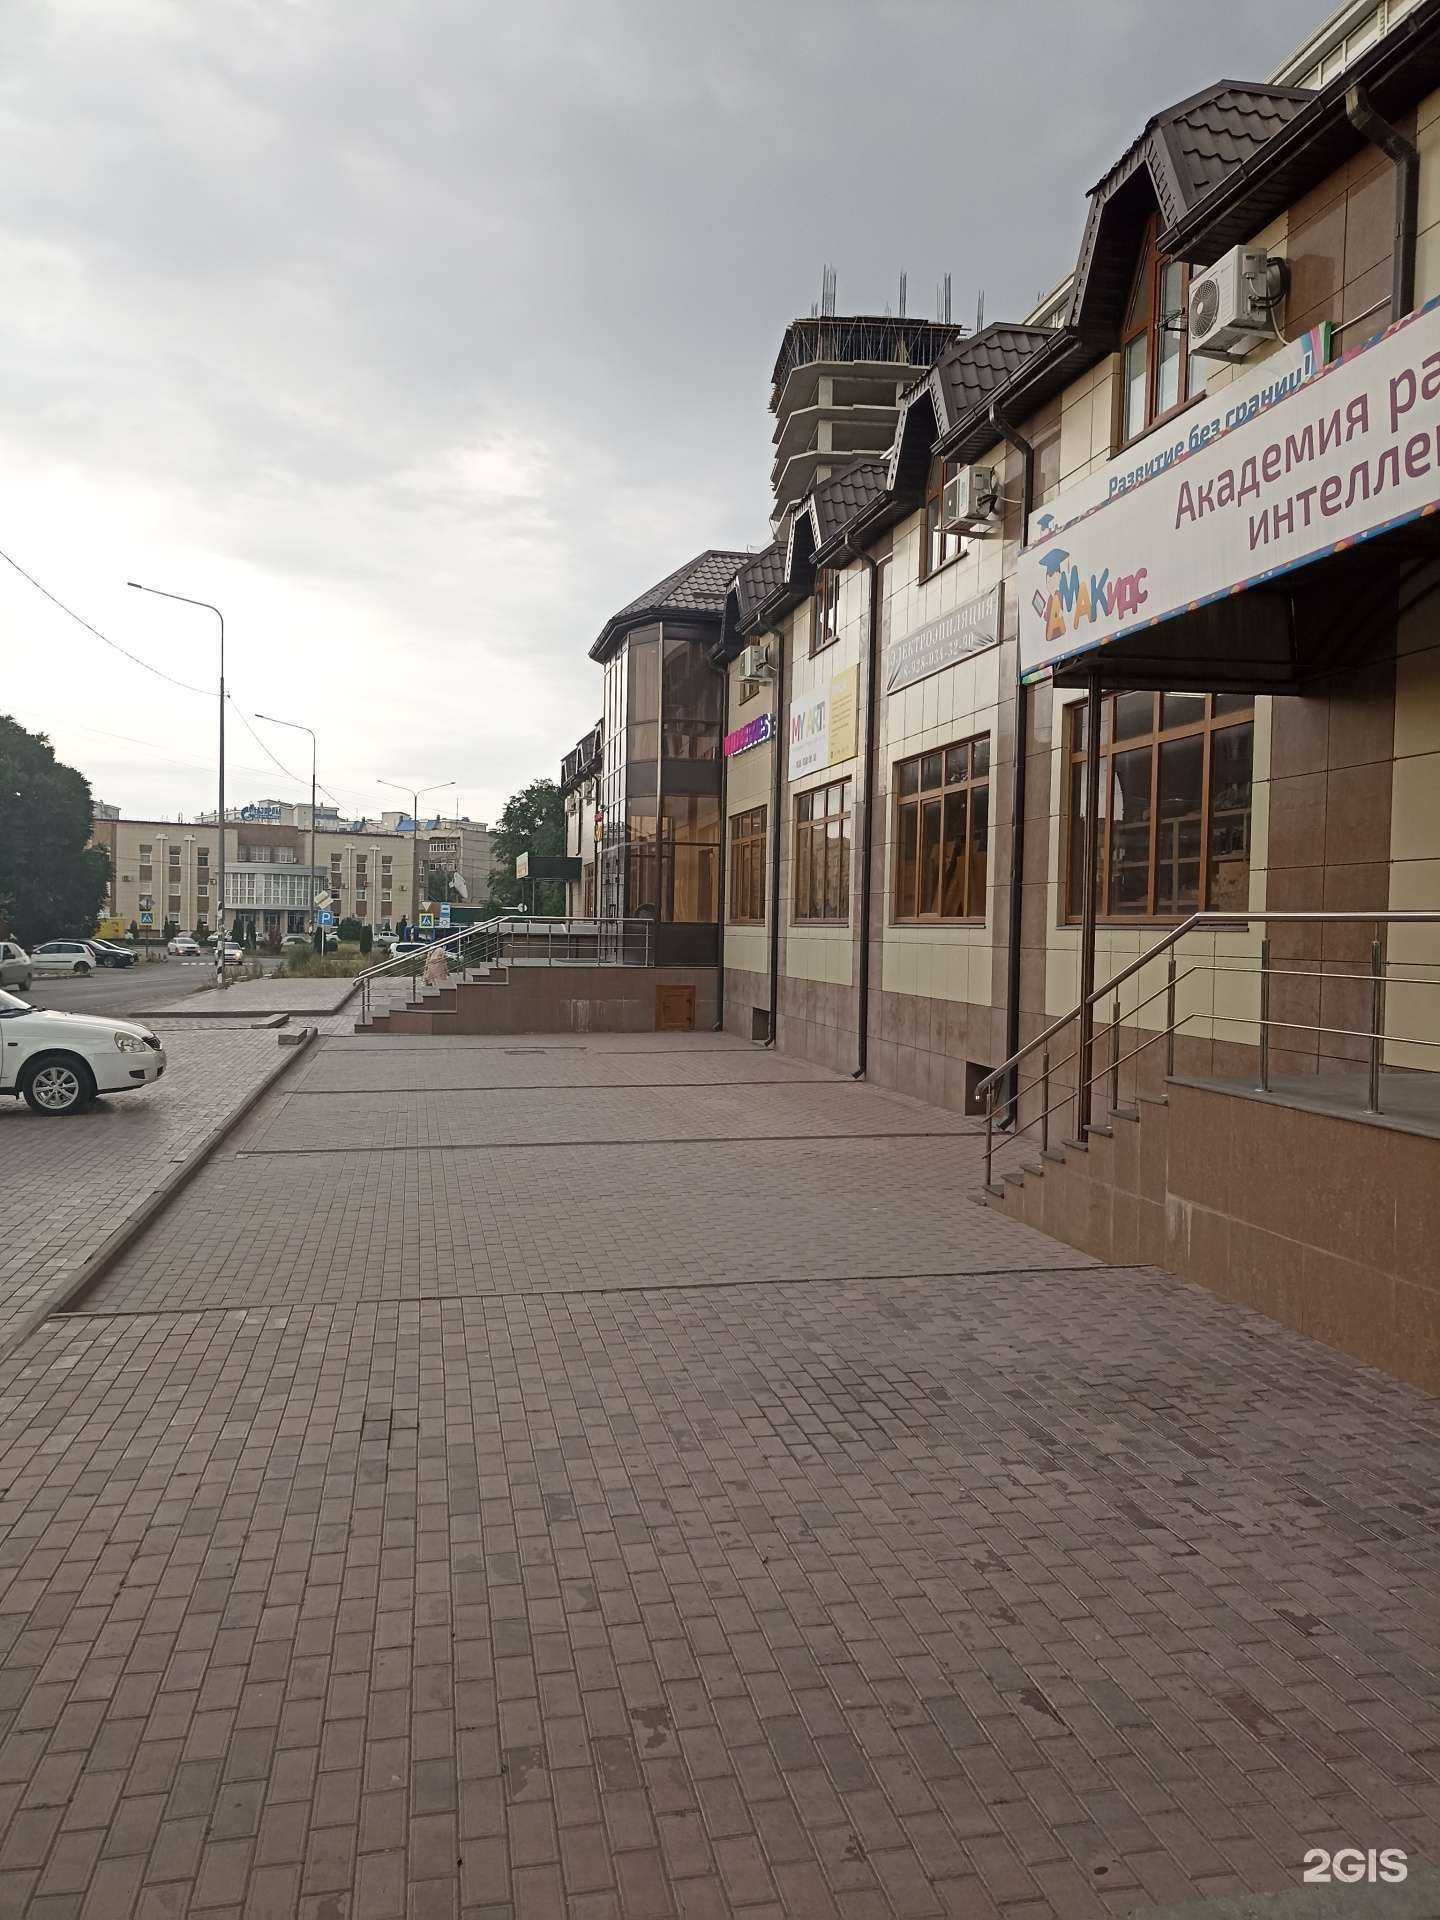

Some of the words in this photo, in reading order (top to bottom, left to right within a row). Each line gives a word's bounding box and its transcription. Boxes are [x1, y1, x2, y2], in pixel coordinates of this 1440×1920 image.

[1108, 440, 1185, 497] Развитие
[1189, 423, 1221, 457] без
[1175, 393, 1369, 530] Академия
[1389, 351, 1440, 434] ра
[1249, 425, 1440, 551] интелле
